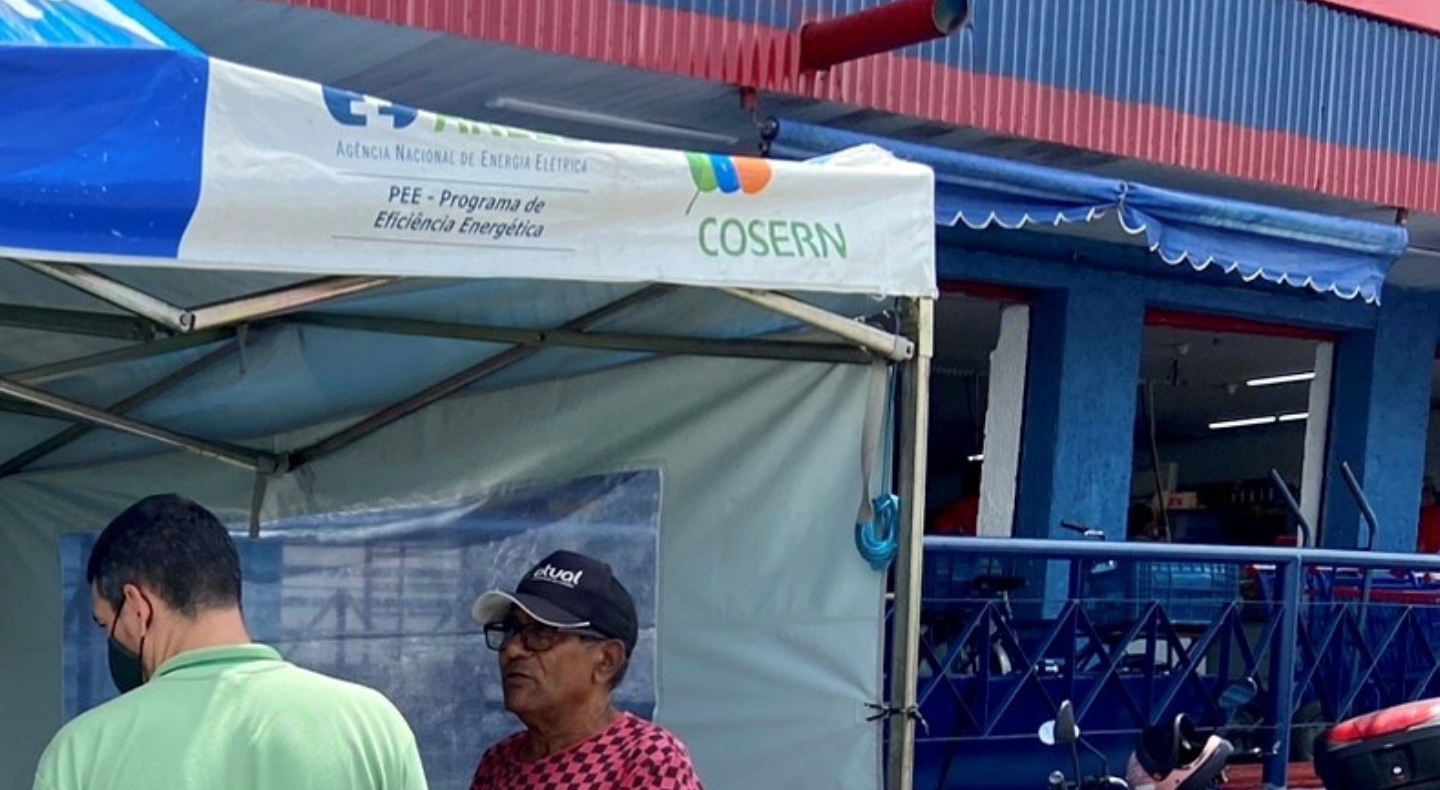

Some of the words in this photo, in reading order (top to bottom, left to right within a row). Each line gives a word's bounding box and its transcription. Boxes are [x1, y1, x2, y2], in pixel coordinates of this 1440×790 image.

[396, 144, 455, 165] NACIONAL
[461, 151, 475, 167] DE
[481, 150, 530, 170] ENERGIA
[535, 153, 588, 174] ELÉTRICA
[388, 186, 422, 204] PEE
[439, 189, 519, 214] Programa
[524, 196, 545, 213] de
[374, 210, 456, 233] Eficiência
[458, 217, 545, 240] Energética
[699, 216, 847, 259] COSERN
